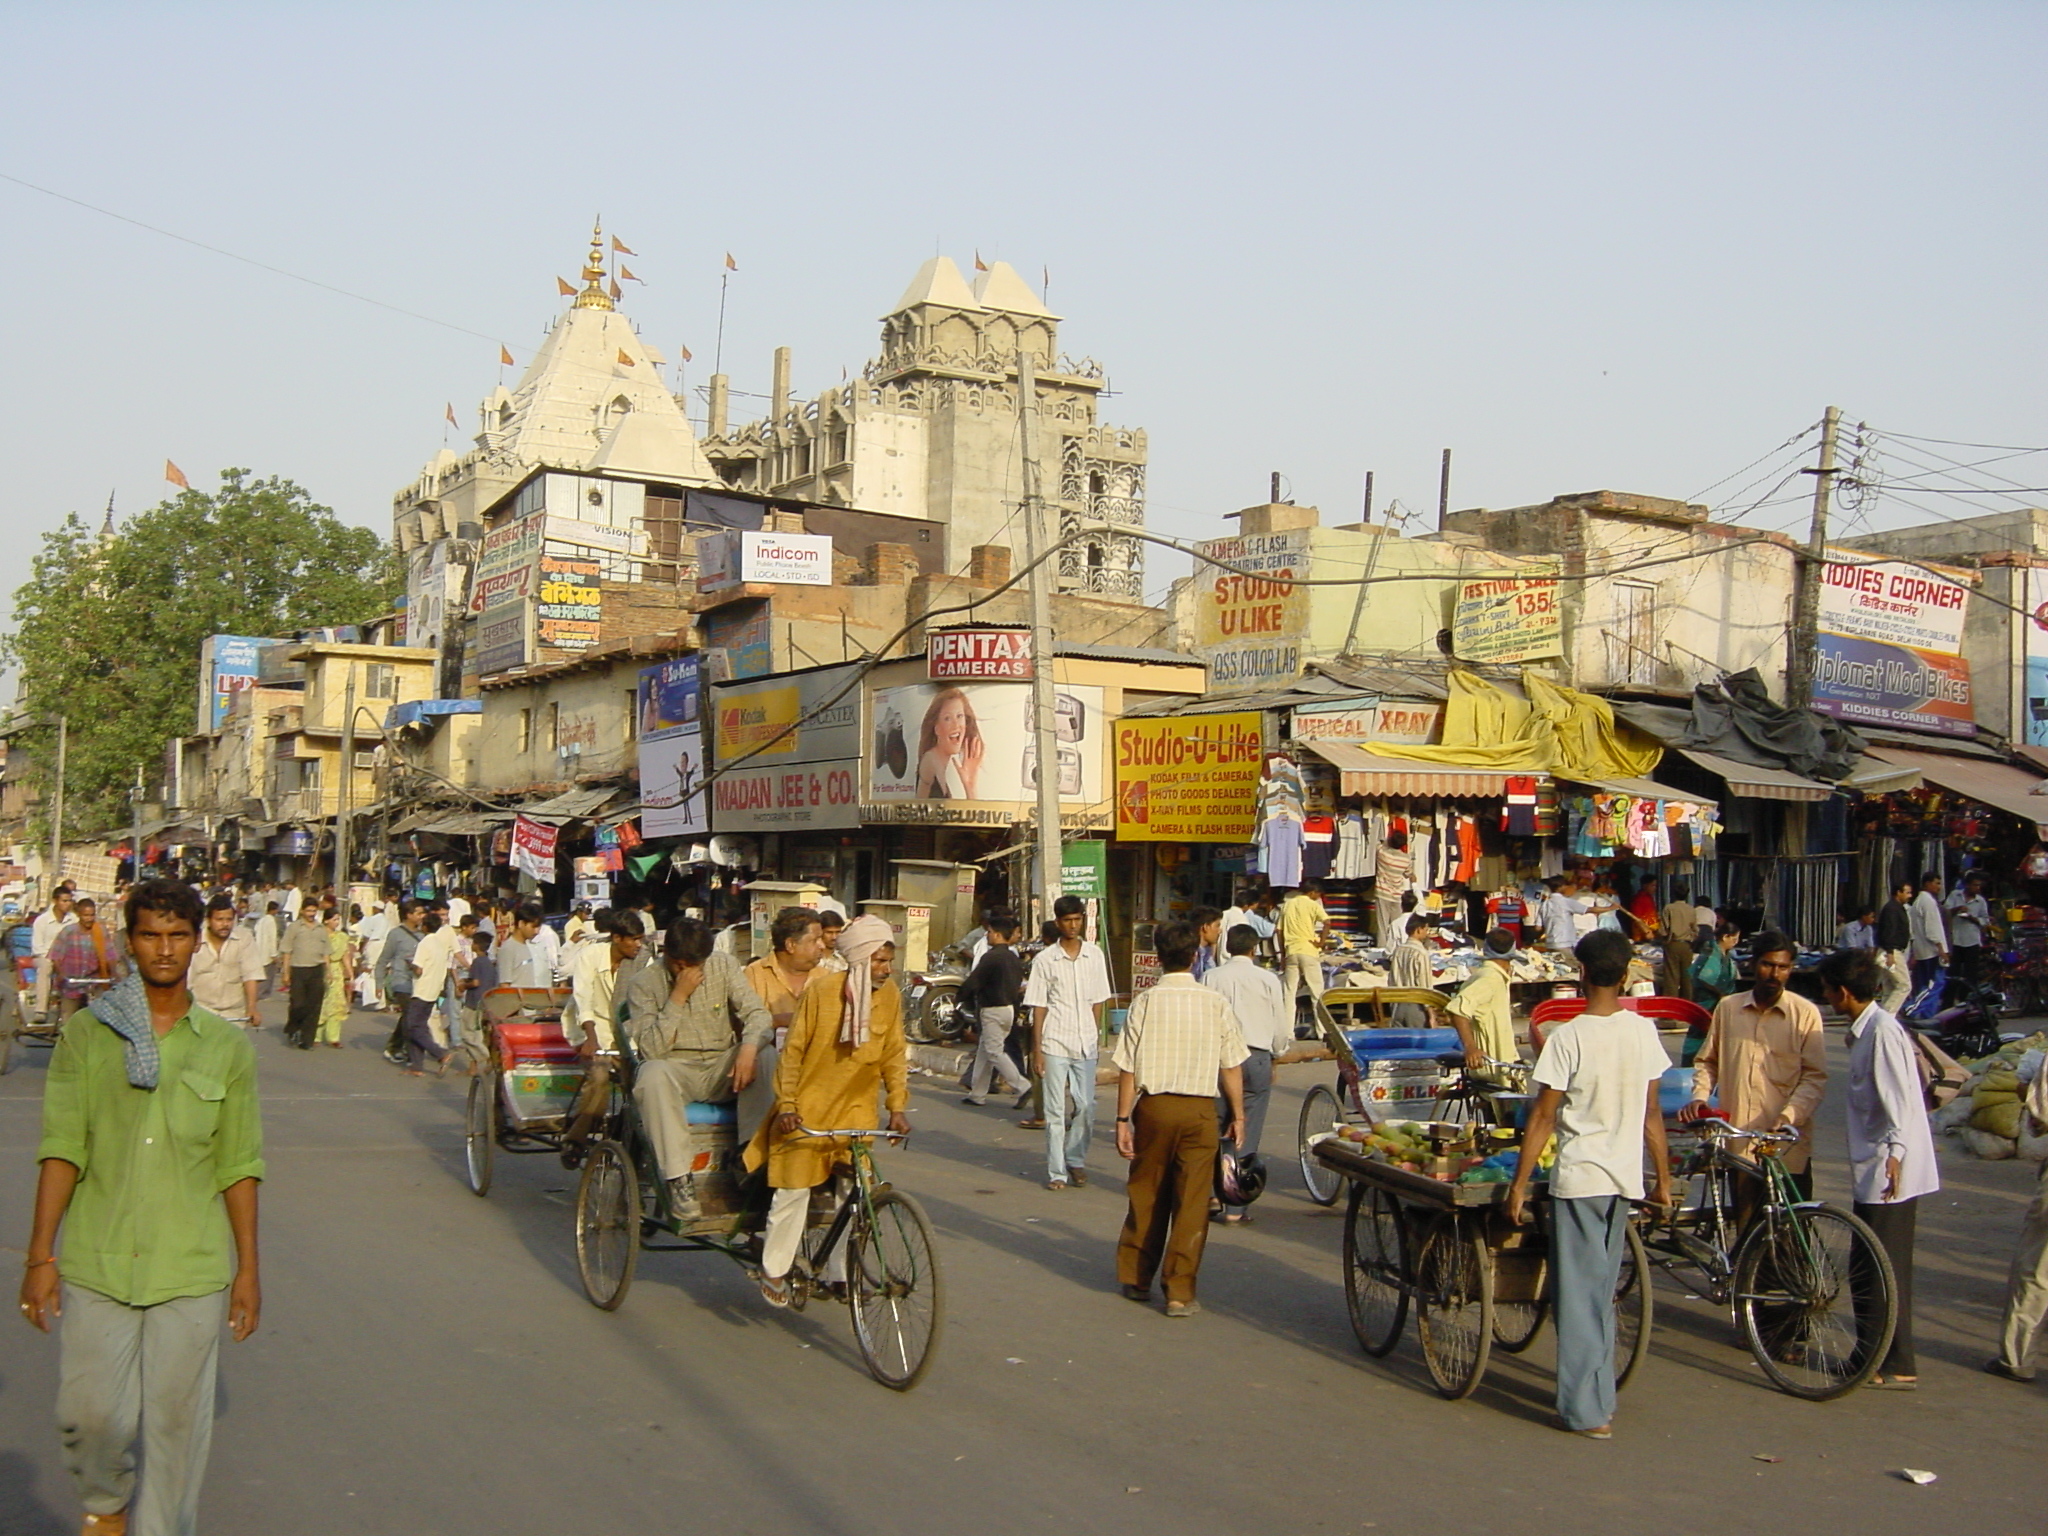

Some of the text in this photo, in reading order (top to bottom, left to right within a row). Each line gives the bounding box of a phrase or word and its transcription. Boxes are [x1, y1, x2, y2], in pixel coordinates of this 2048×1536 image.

[594, 525, 631, 538] VISION
[757, 545, 818, 561] Indicom
[1203, 540, 1246, 560] CAMERA
[1256, 535, 1288, 555] FLASH
[1267, 553, 1297, 568] CENTRE
[754, 570, 780, 578] LOCAL
[786, 572, 802, 580] STD
[1215, 568, 1294, 605] STUDIO
[1464, 573, 1558, 600] FESTIVAL SALE
[1889, 575, 1964, 610] CORNER
[1220, 604, 1282, 635] U LIKE
[932, 633, 1033, 661] PENTAX
[937, 661, 1025, 676] CAMERAS
[1214, 647, 1297, 680] QSS COLOR LAB
[1885, 660, 1924, 697] Mod
[741, 706, 766, 725] Kodak
[1841, 703, 1889, 718] KIDDIES
[1891, 711, 1938, 724] CORNER
[1297, 717, 1366, 737] MEDICAL
[1119, 723, 1259, 767] Studio-U-Like
[1150, 771, 1253, 784] KODAK FILM & CAMERAS
[715, 770, 856, 811] MADAN JEE & CO.
[1150, 788, 1251, 800] PHOTO GOODS DEALERS
[1177, 805, 1202, 815] FILMS
[1206, 805, 1242, 816] COLOUR
[1150, 824, 1185, 834] CAMERA
[1186, 824, 1192, 834] &
[1195, 824, 1222, 834] FLASH
